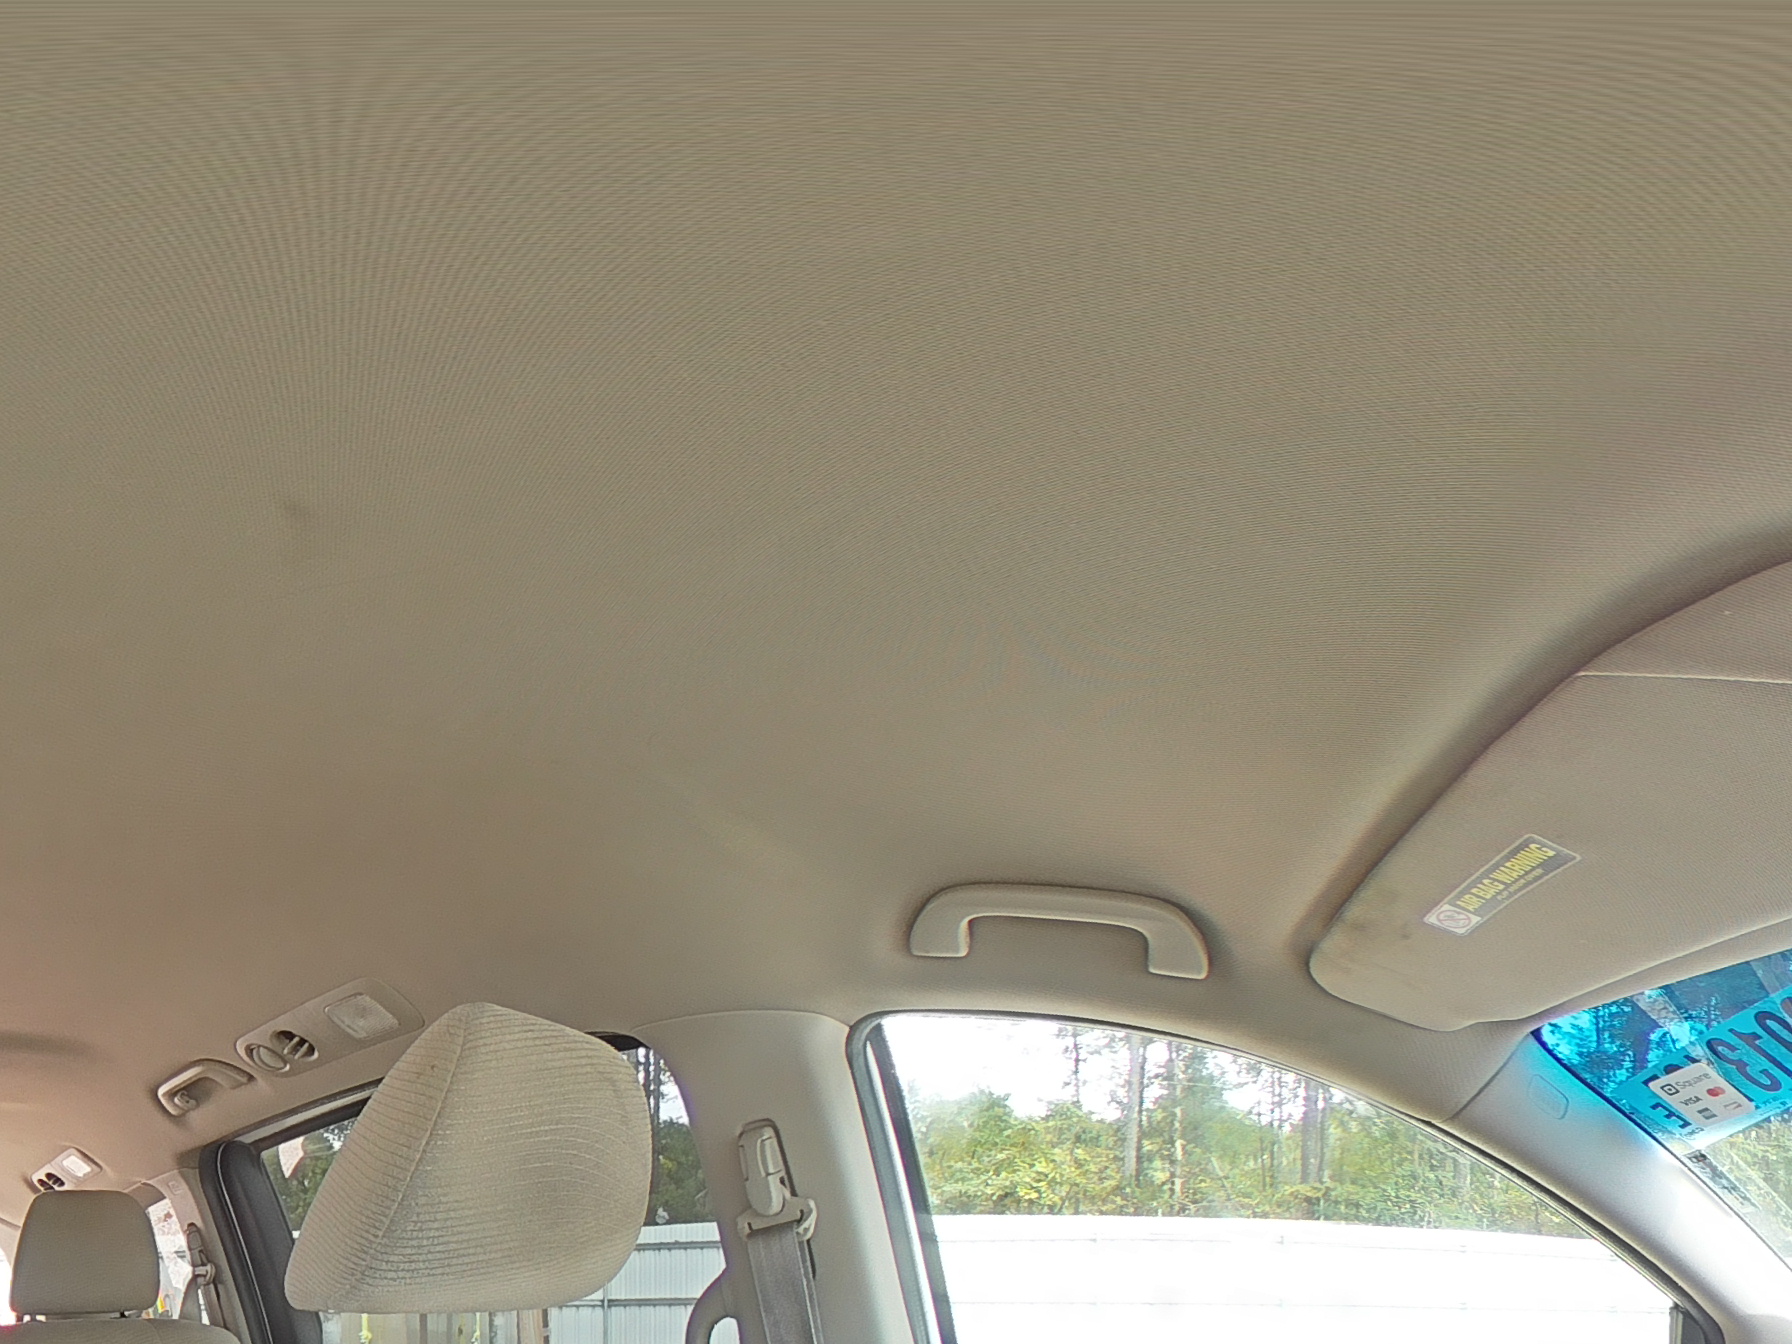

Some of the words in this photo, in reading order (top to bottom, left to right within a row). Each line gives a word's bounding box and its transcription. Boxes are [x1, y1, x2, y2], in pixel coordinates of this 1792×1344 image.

[1456, 892, 1485, 912] AIR
[1472, 878, 1506, 900] BAG
[1489, 843, 1557, 884] WARNING
[1675, 1072, 1712, 1090] Square
[1679, 1095, 1703, 1107] VISA
